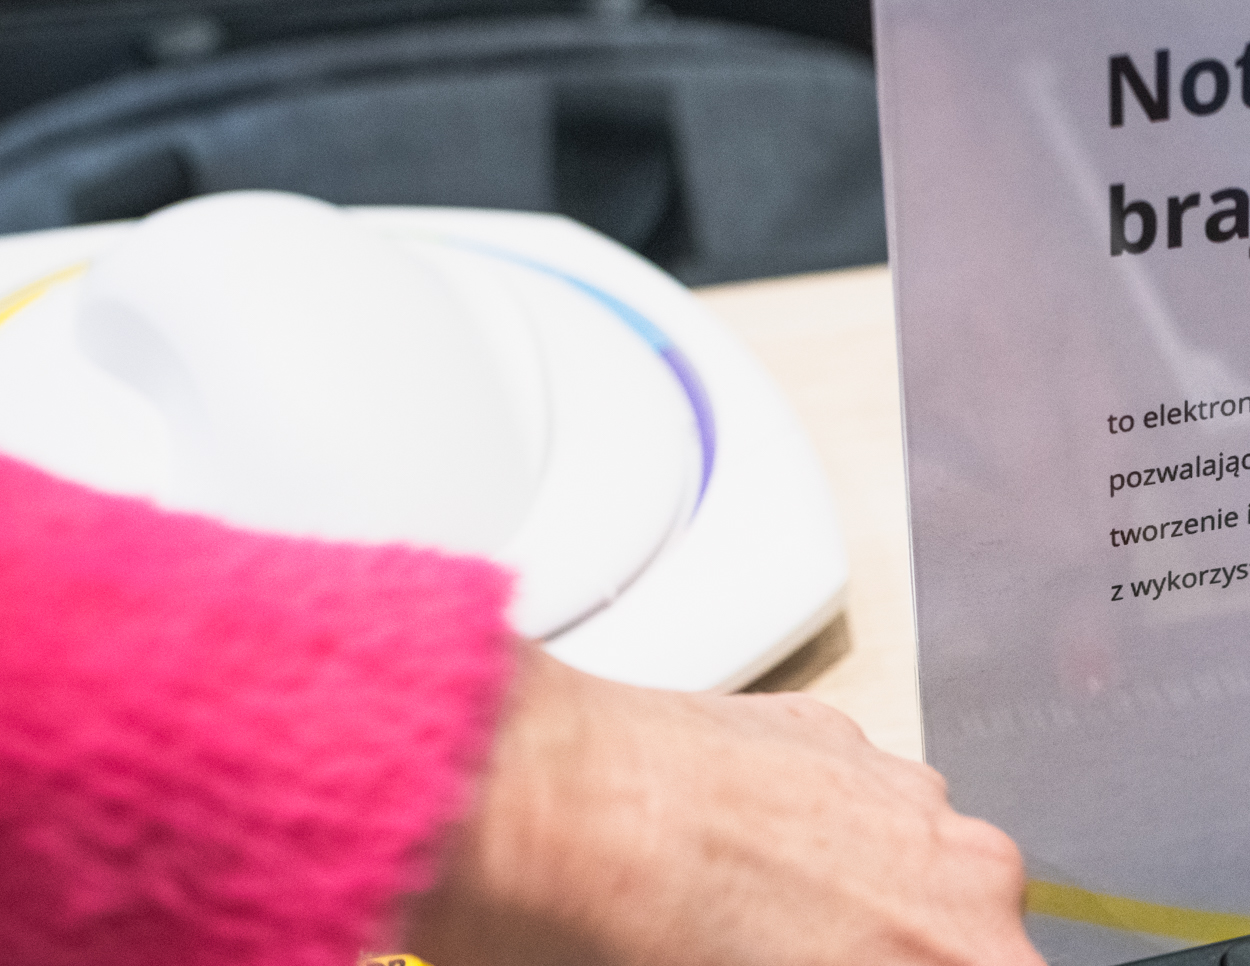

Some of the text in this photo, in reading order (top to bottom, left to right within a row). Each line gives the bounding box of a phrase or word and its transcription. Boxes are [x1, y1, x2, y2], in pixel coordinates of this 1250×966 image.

[1107, 414, 1135, 434] to
[1109, 508, 1239, 547] tworzenie
[1110, 584, 1124, 601] z
